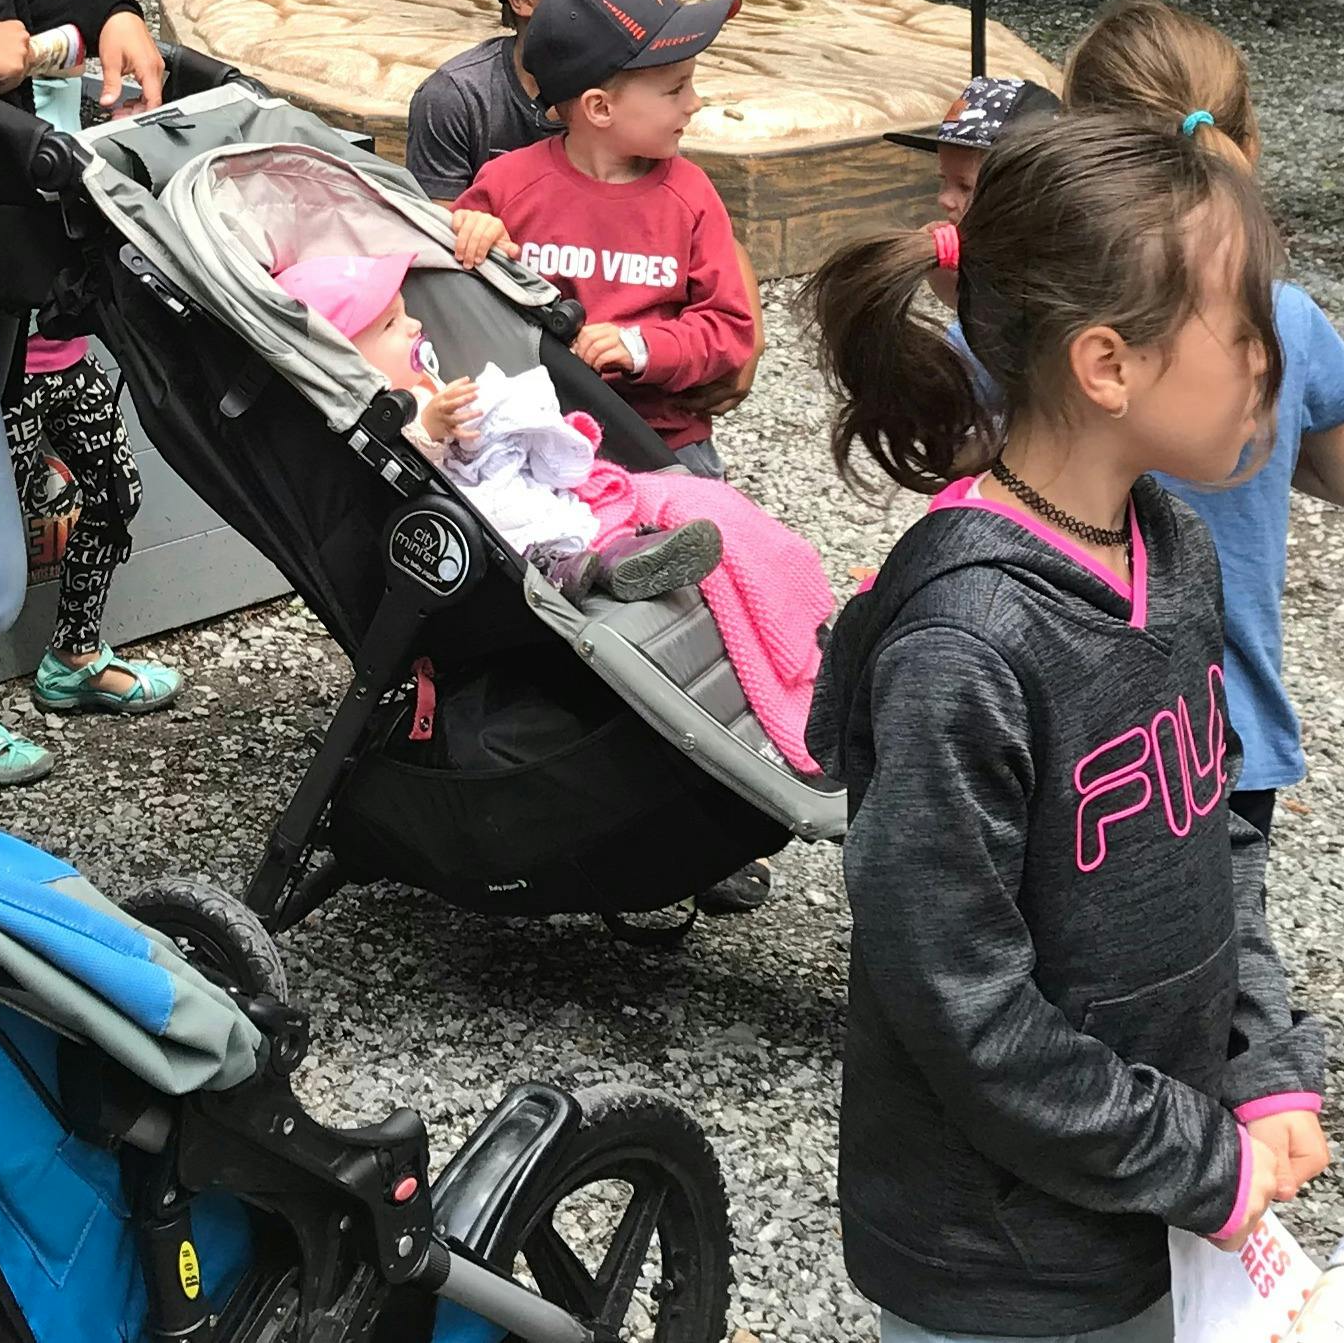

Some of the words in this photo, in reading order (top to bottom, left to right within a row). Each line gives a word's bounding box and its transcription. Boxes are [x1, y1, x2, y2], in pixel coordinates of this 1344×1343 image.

[520, 242, 596, 279] GOOD
[601, 249, 678, 288] VIBES
[395, 532, 425, 557] mini
[413, 527, 439, 551] city
[1239, 1243, 1275, 1298] RES
[1252, 1219, 1292, 1276] CES
